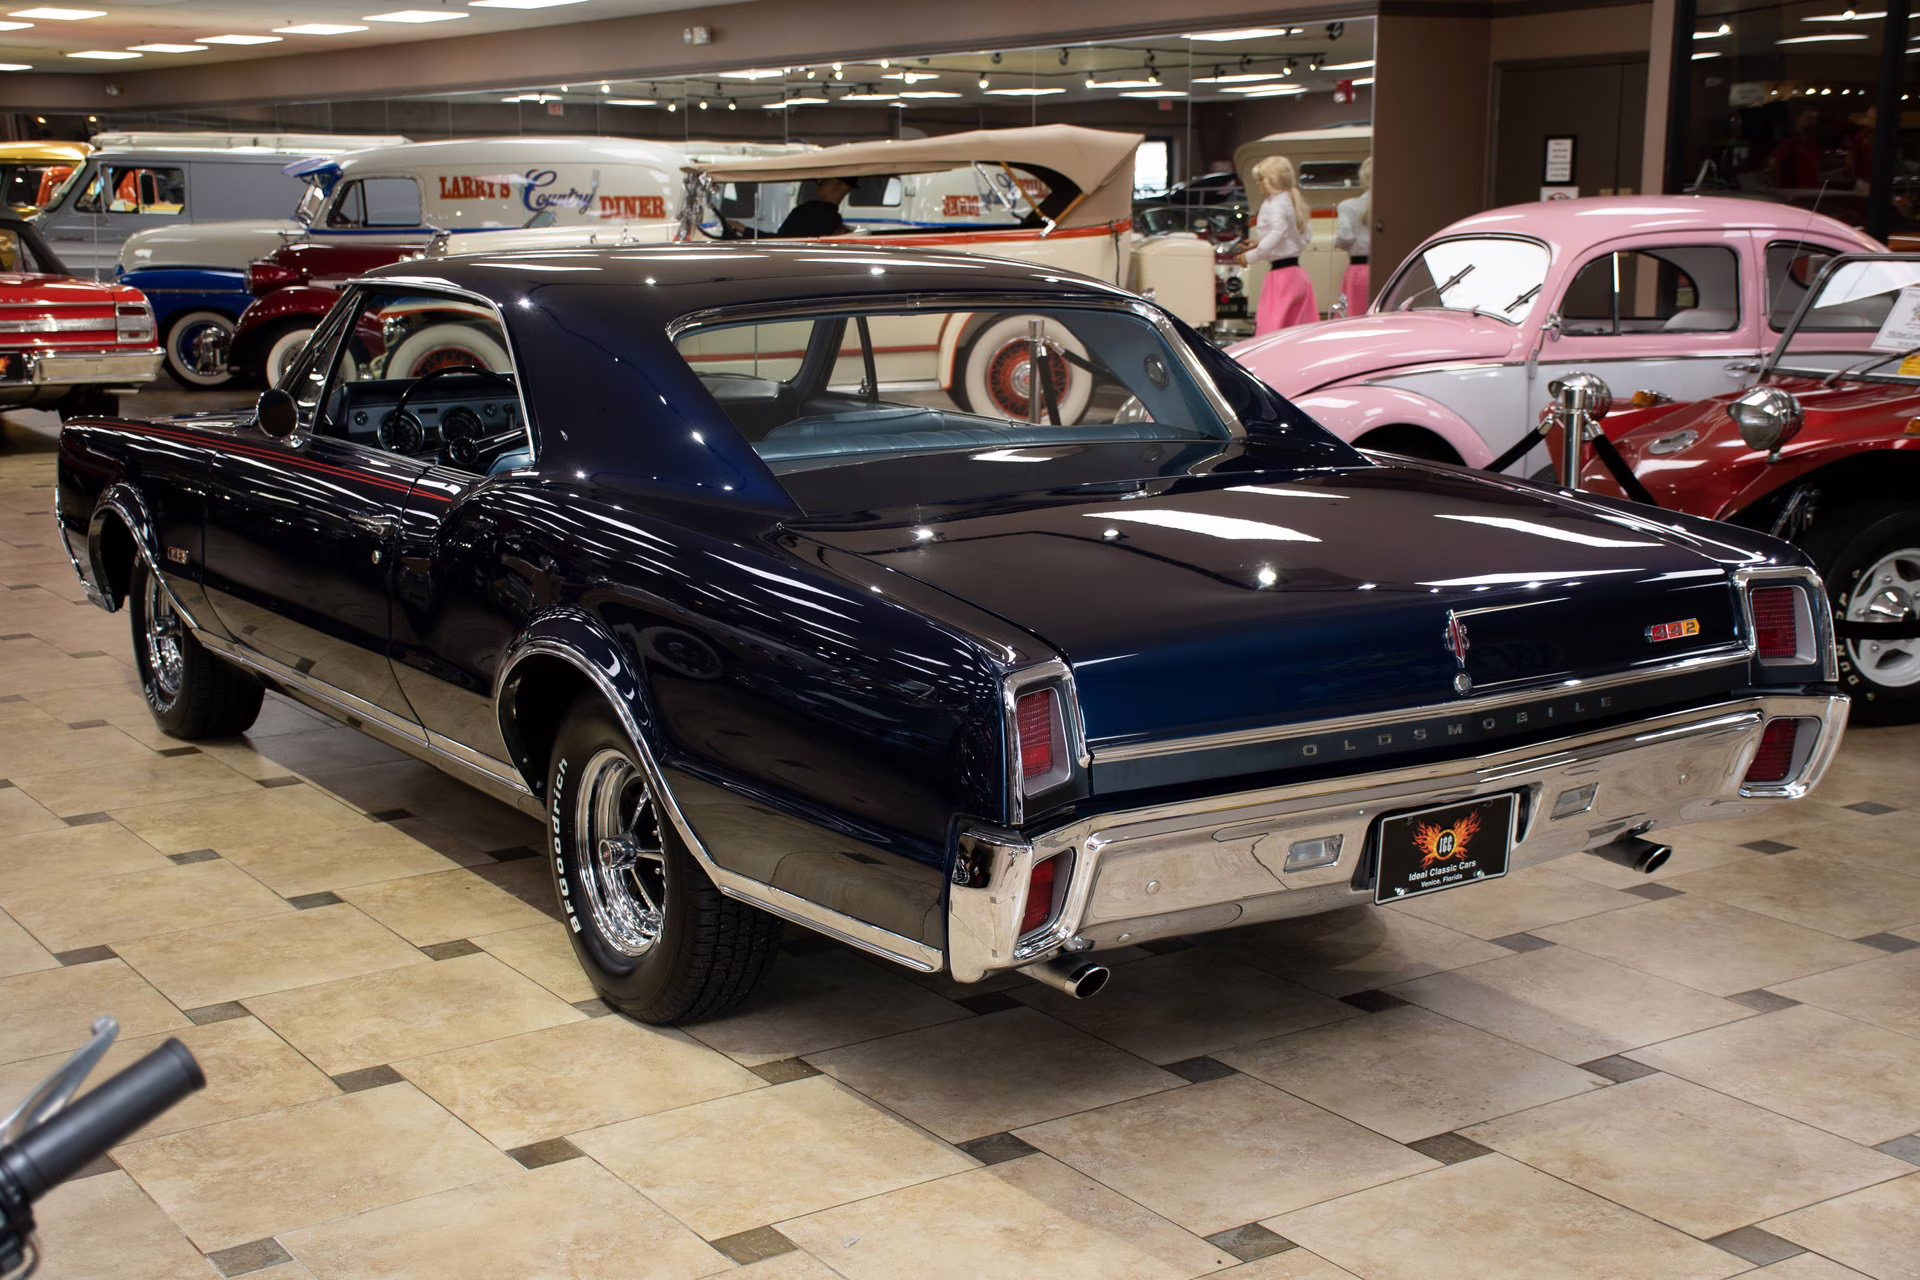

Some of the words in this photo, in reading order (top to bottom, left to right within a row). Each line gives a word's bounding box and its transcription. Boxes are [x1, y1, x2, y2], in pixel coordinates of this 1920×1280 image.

[439, 175, 511, 200] LARRY'S
[523, 169, 594, 215] Country
[599, 196, 666, 219] DINER
[1655, 620, 1698, 639] 442
[1835, 592, 1860, 686] DUNOP
[1303, 697, 1612, 757] OLDSMOBILE
[551, 758, 583, 934] BFGoodrich
[1439, 835, 1453, 854] ICC
[1408, 870, 1428, 881] Ideal
[1429, 864, 1457, 877] Classic
[1459, 860, 1477, 870] Cars
[1442, 873, 1463, 883] Florida
